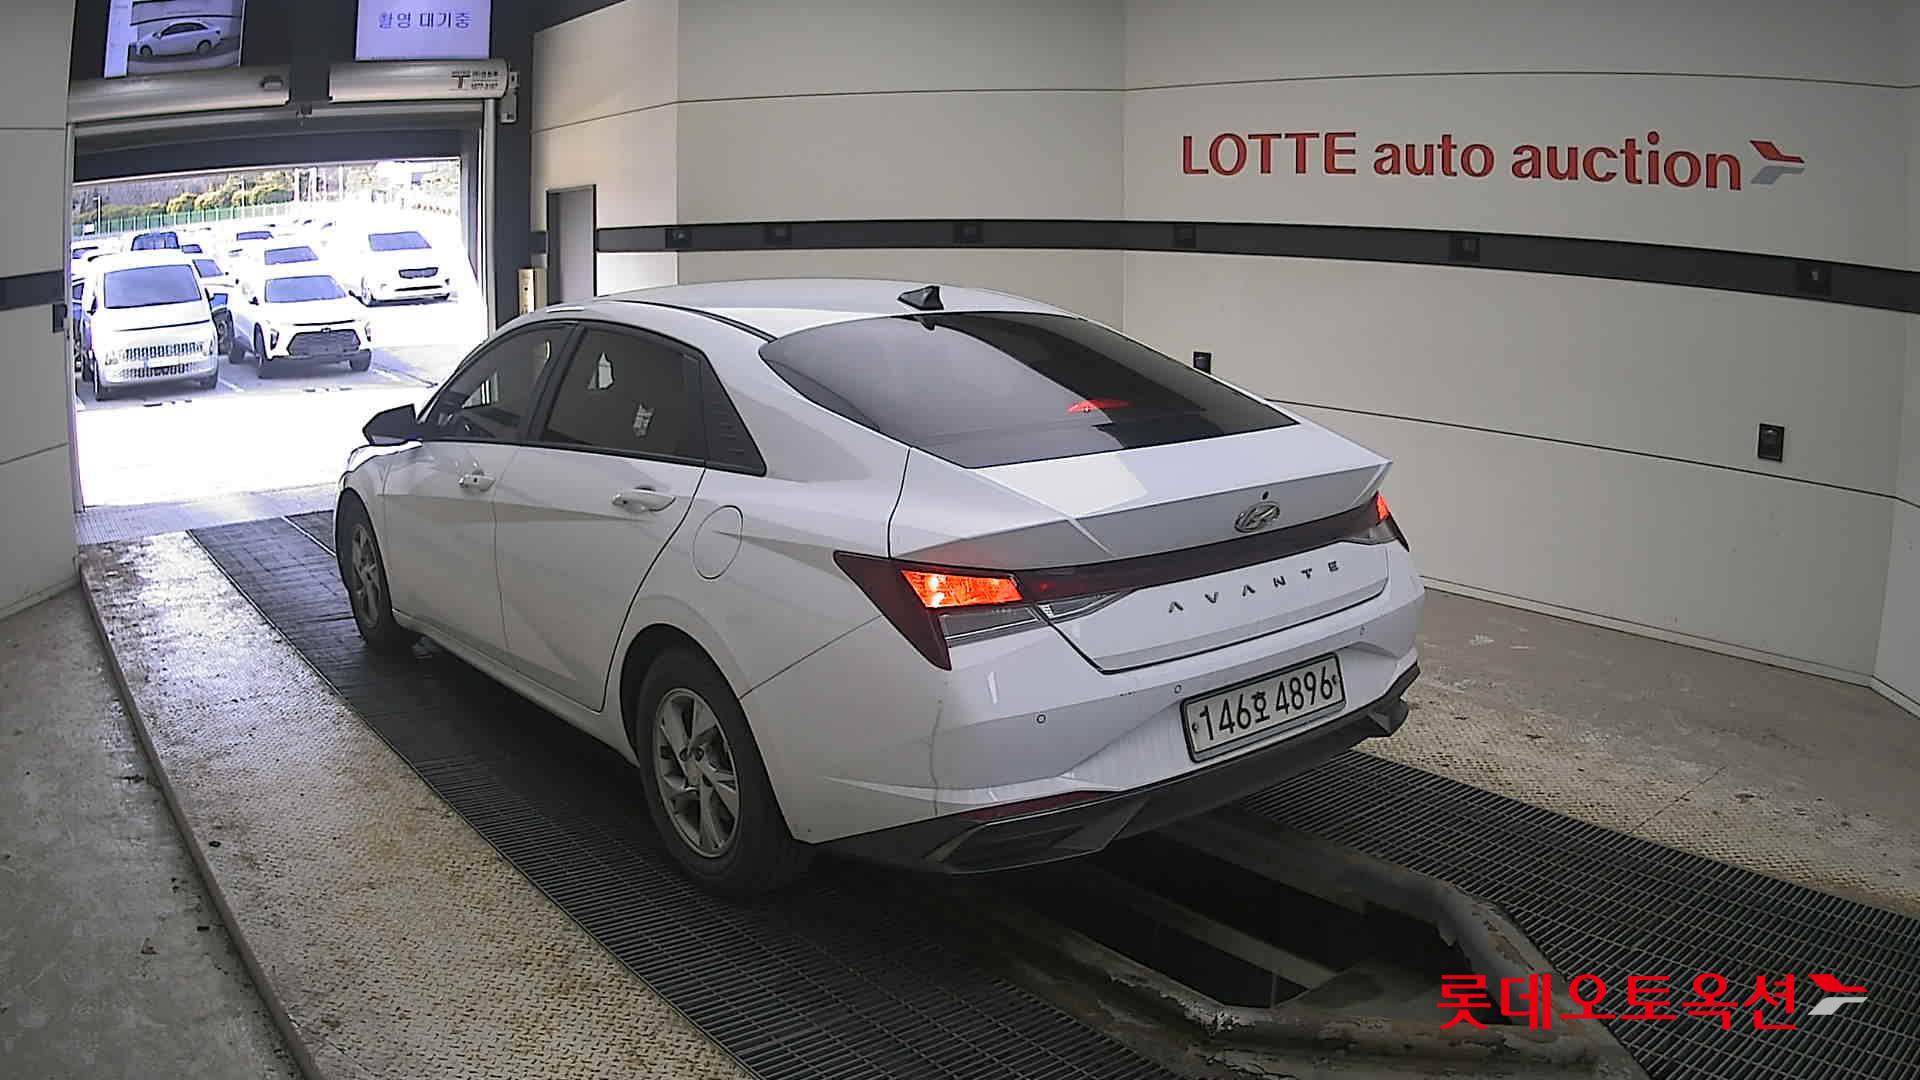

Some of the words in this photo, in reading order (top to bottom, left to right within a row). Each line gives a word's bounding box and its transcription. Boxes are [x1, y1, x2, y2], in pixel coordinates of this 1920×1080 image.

[419, 11, 472, 29] 대기중
[1182, 132, 1356, 175] LOTTE
[1374, 134, 1495, 178] auto
[1511, 131, 1742, 190] auction
[1167, 560, 1339, 614] AVANTE
[1199, 690, 1271, 741] 146호
[1275, 665, 1334, 715] 4896
